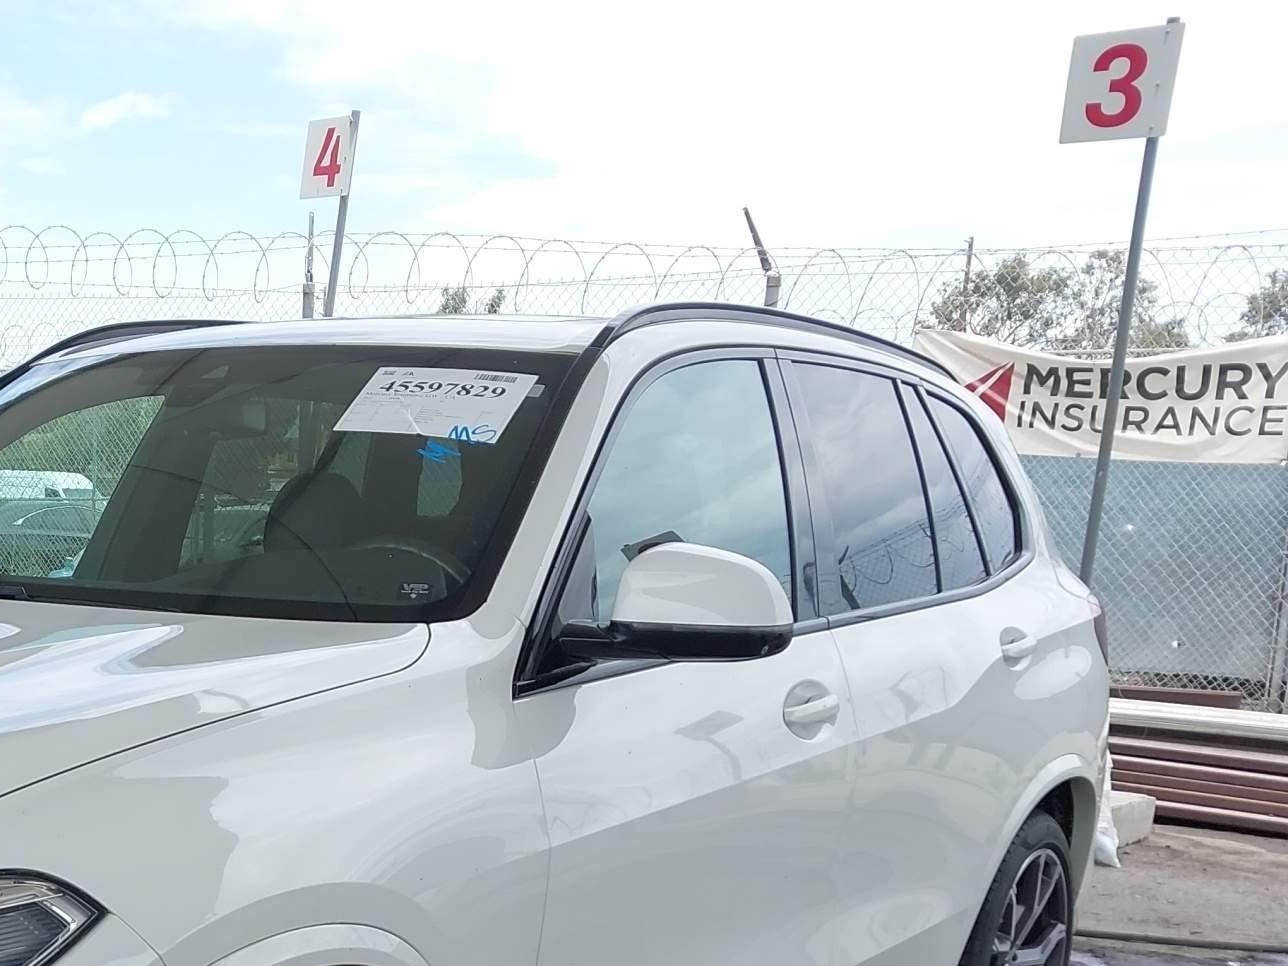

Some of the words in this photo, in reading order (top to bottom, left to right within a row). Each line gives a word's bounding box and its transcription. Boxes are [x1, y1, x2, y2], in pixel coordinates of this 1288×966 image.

[1085, 43, 1148, 128] 3
[313, 127, 341, 187] 4
[378, 380, 507, 399] 45597829
[1022, 362, 1288, 400] MERCURY
